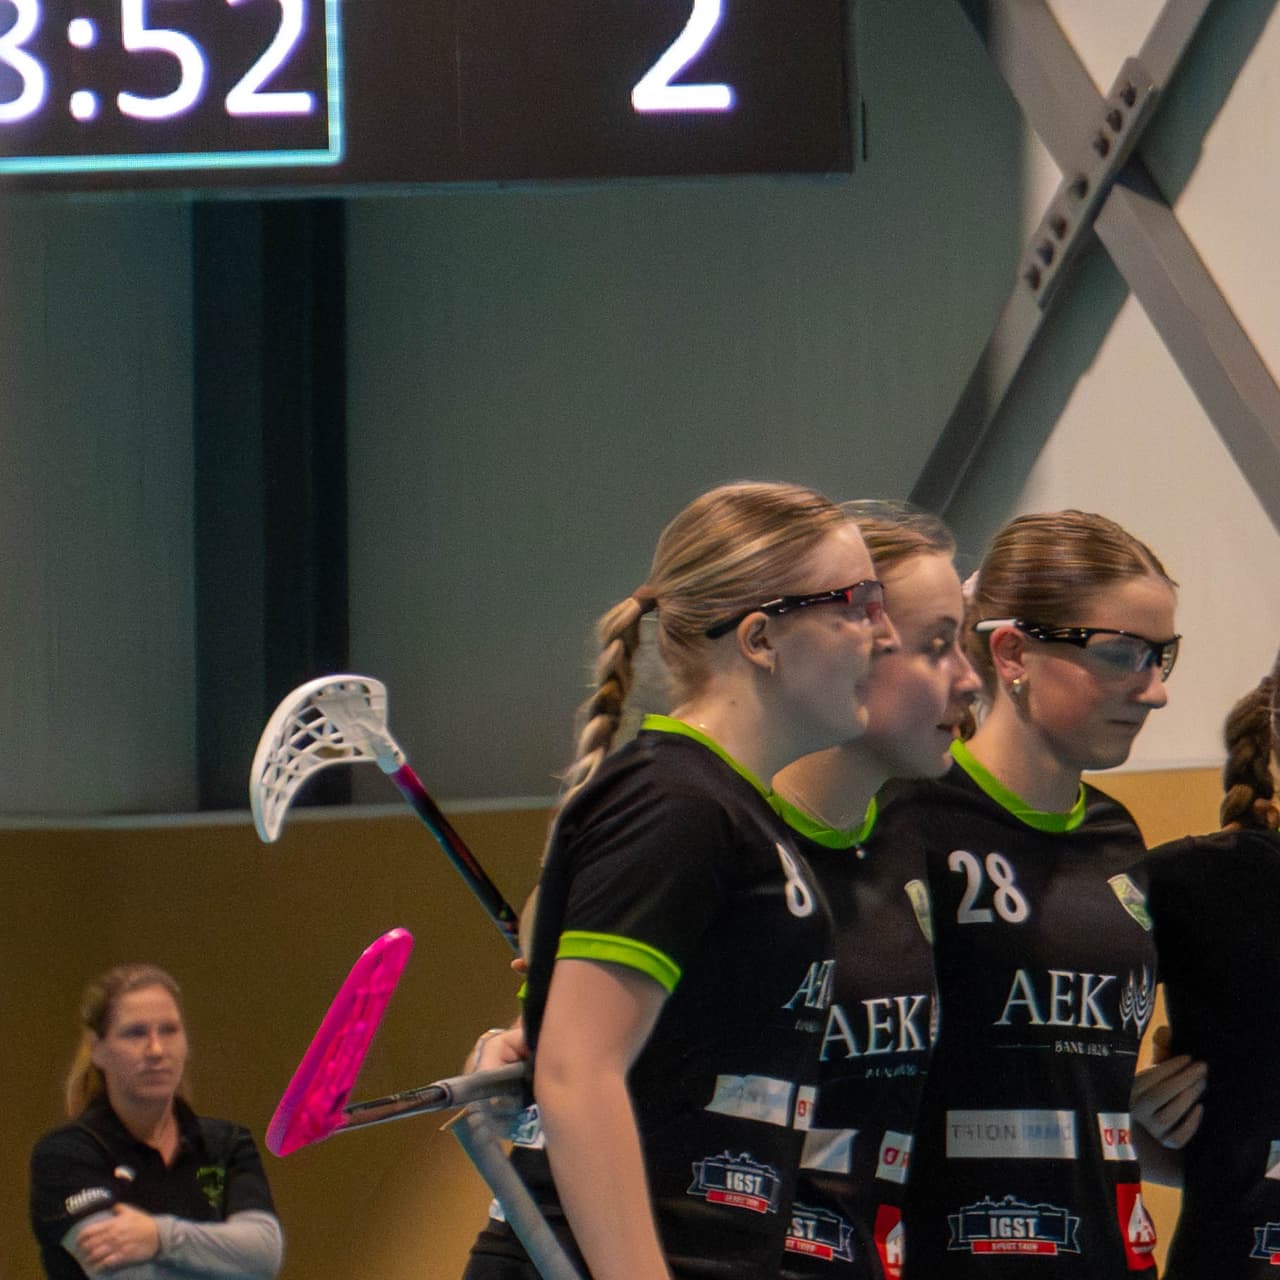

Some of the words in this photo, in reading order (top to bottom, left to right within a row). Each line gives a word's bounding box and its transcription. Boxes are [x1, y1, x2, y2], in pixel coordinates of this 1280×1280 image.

[631, 0, 735, 113] 2
[947, 849, 1031, 924] 28
[820, 994, 928, 1062] AEK
[993, 967, 1118, 1031] AEK
[725, 1170, 763, 1196] IGST
[786, 1216, 817, 1241] ST
[989, 1217, 1038, 1238] IGST
